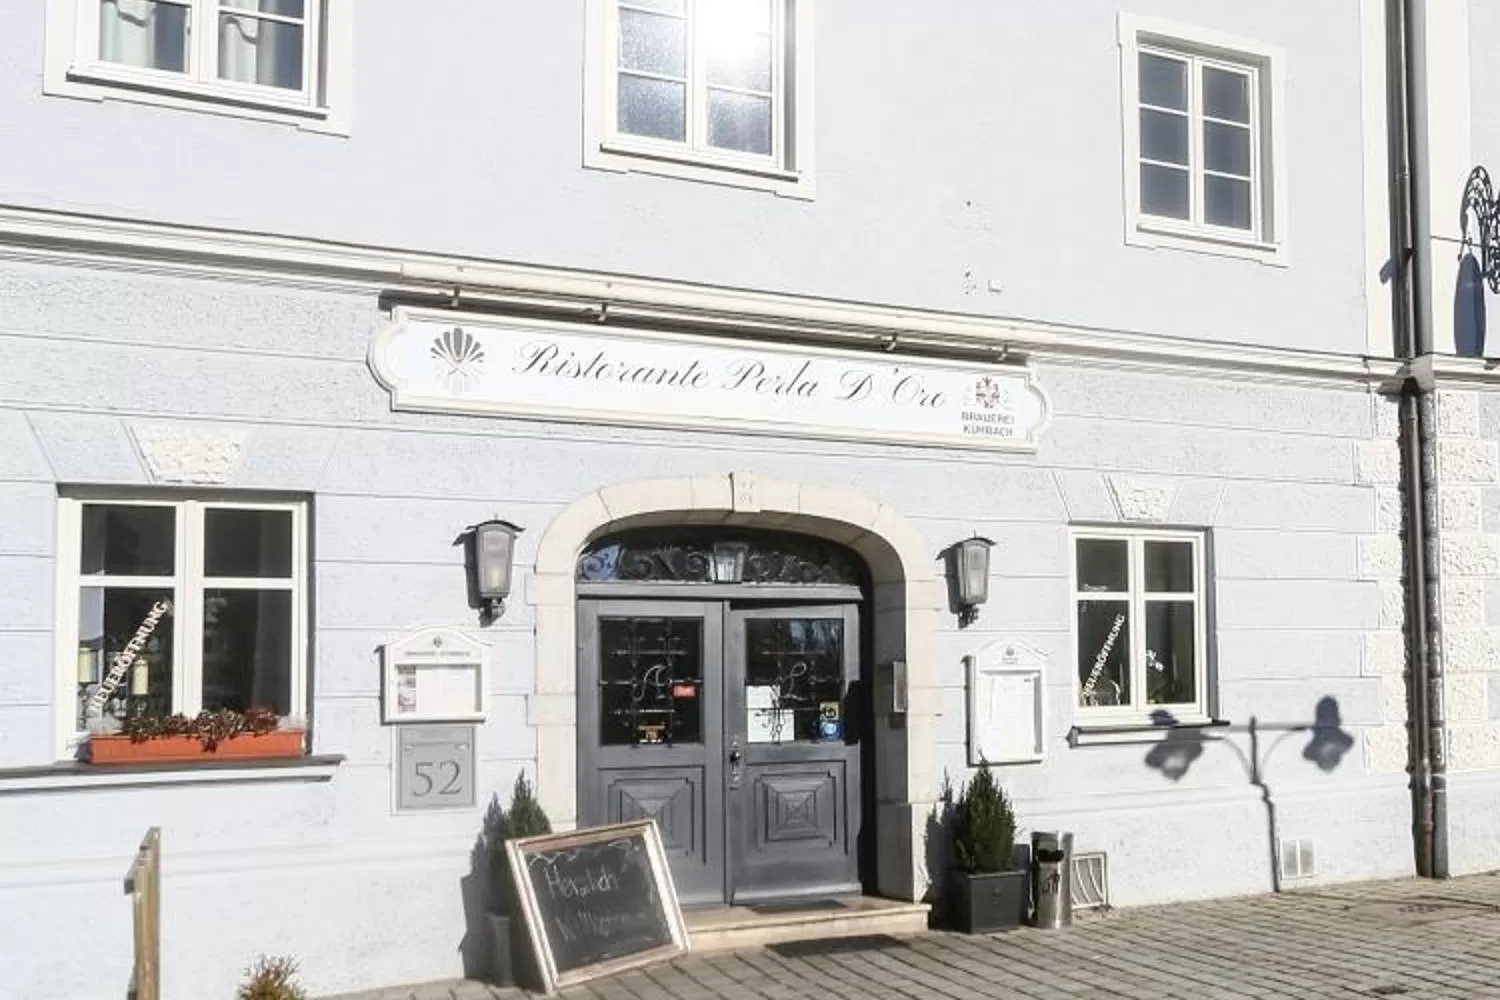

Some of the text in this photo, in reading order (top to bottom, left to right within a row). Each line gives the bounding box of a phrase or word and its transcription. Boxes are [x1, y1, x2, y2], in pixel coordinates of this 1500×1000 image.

[511, 341, 710, 389] Ristorante
[721, 359, 819, 399] Perla
[412, 760, 463, 798] 52
